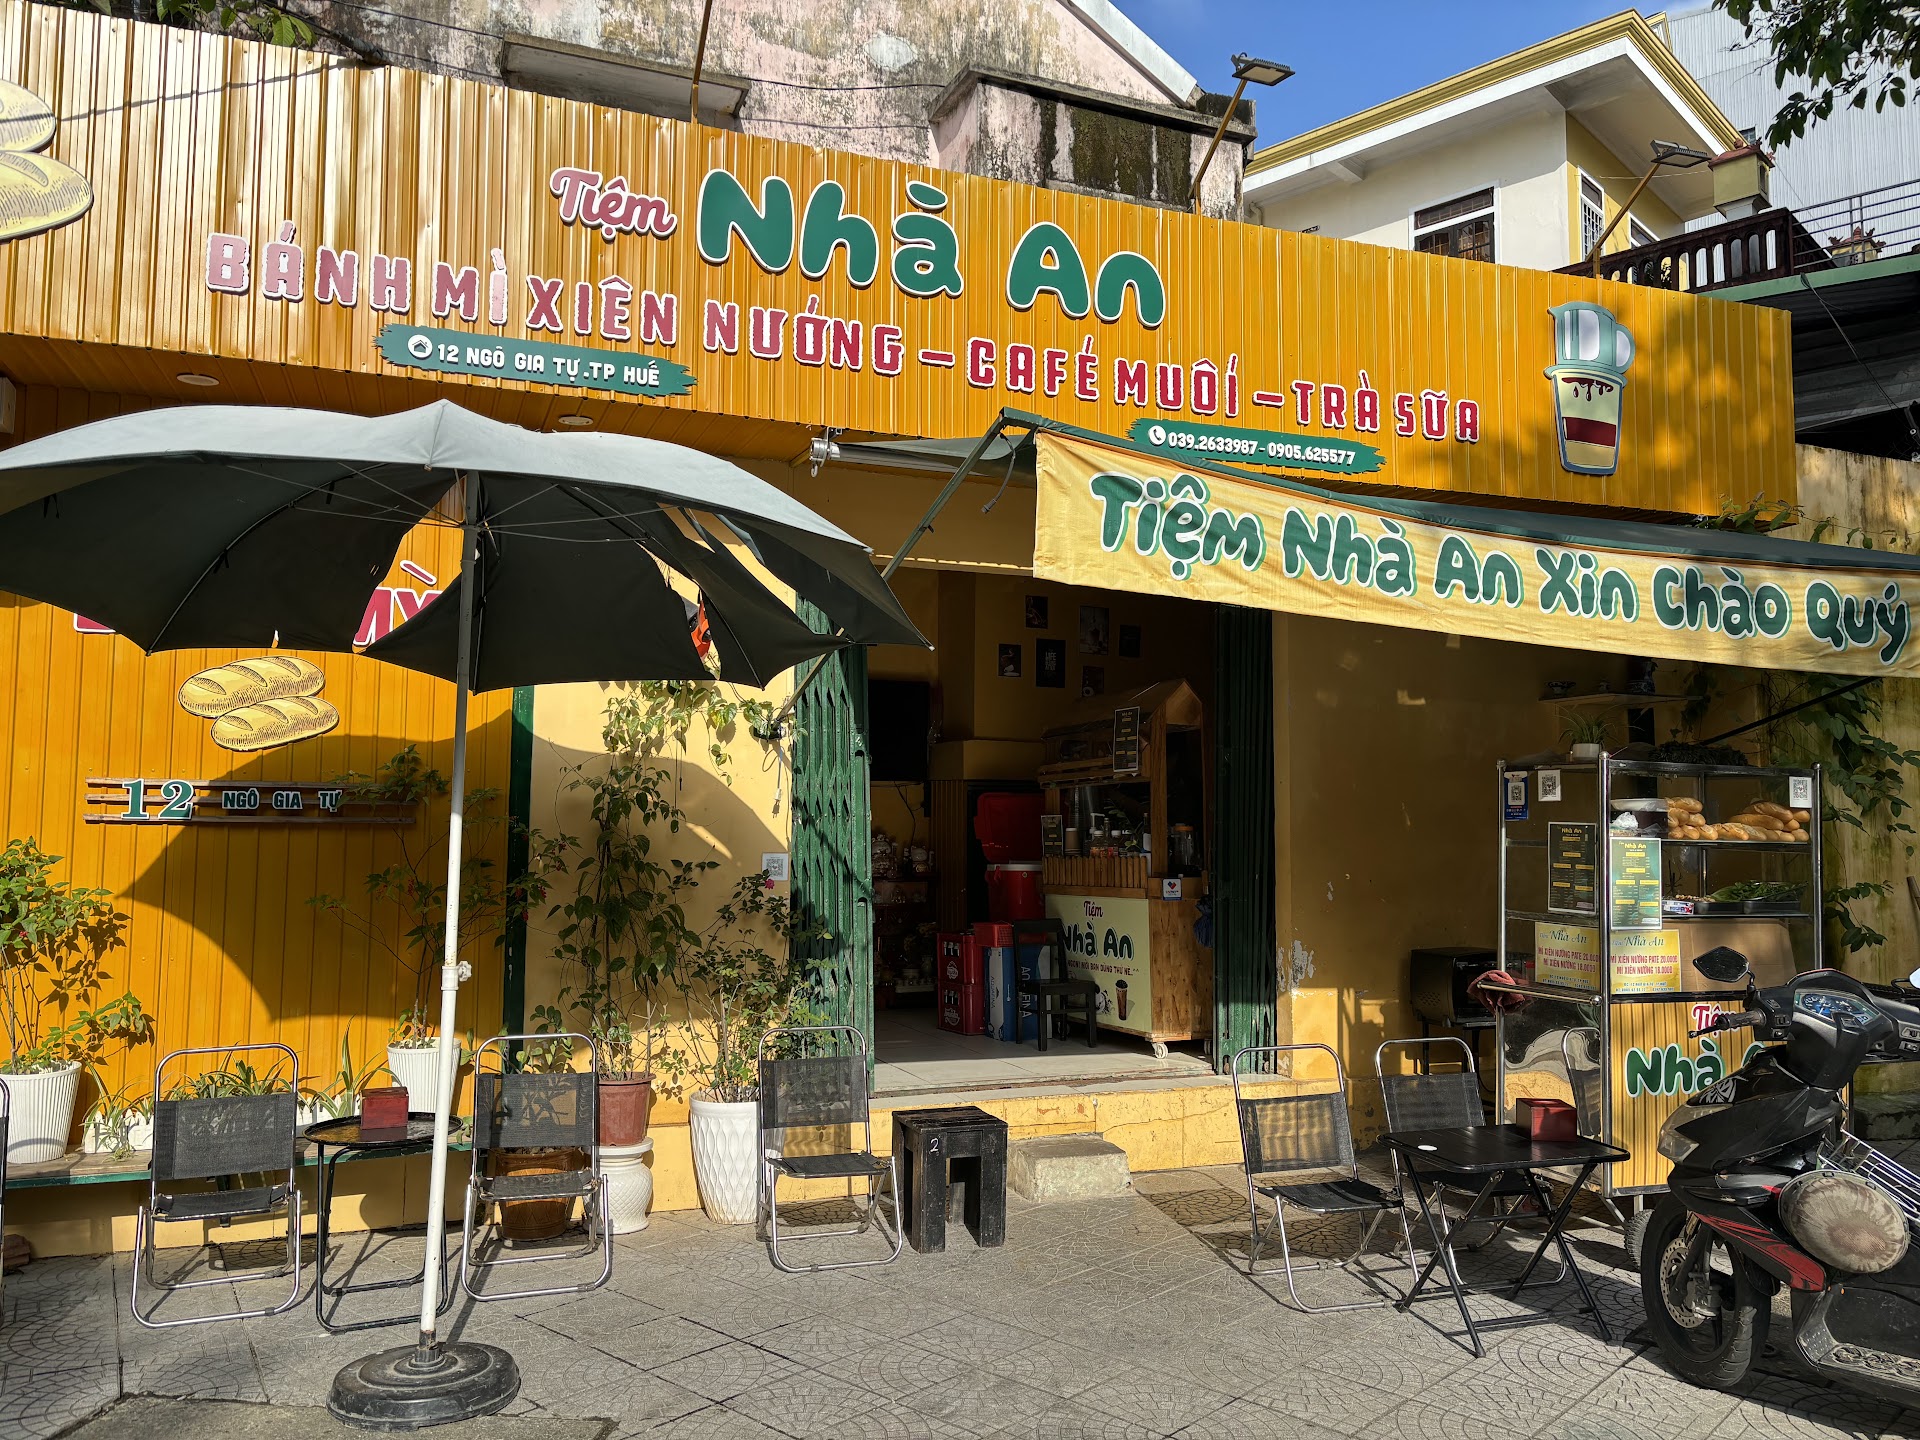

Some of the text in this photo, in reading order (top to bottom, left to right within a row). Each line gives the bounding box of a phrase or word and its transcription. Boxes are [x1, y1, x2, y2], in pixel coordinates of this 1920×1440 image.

[550, 167, 1166, 328] Tiệm Nhà An
[206, 220, 411, 313] BÁNH
[432, 248, 507, 325] MÌ
[526, 274, 677, 345] XIÊN
[703, 294, 904, 376] NƯỚNG
[967, 335, 1100, 400] CAFÉ
[1114, 353, 1239, 418] MUỐI
[1291, 369, 1380, 433] TRÀ
[1394, 388, 1480, 443] SỮA
[438, 343, 459, 363] 12
[466, 345, 506, 368] NGÔ
[514, 352, 545, 372] GIA
[623, 360, 660, 386] HUẾ
[1089, 472, 1912, 667] Tiệm Nhà An Xin Chào Quý
[121, 778, 195, 820] 12
[222, 788, 260, 810] NGÔ
[272, 790, 304, 811] GIA
[1083, 900, 1104, 921] Tiệm
[1102, 926, 1134, 962] An
[1625, 1036, 1727, 1098] Nhà
[930, 1137, 939, 1152] 2
